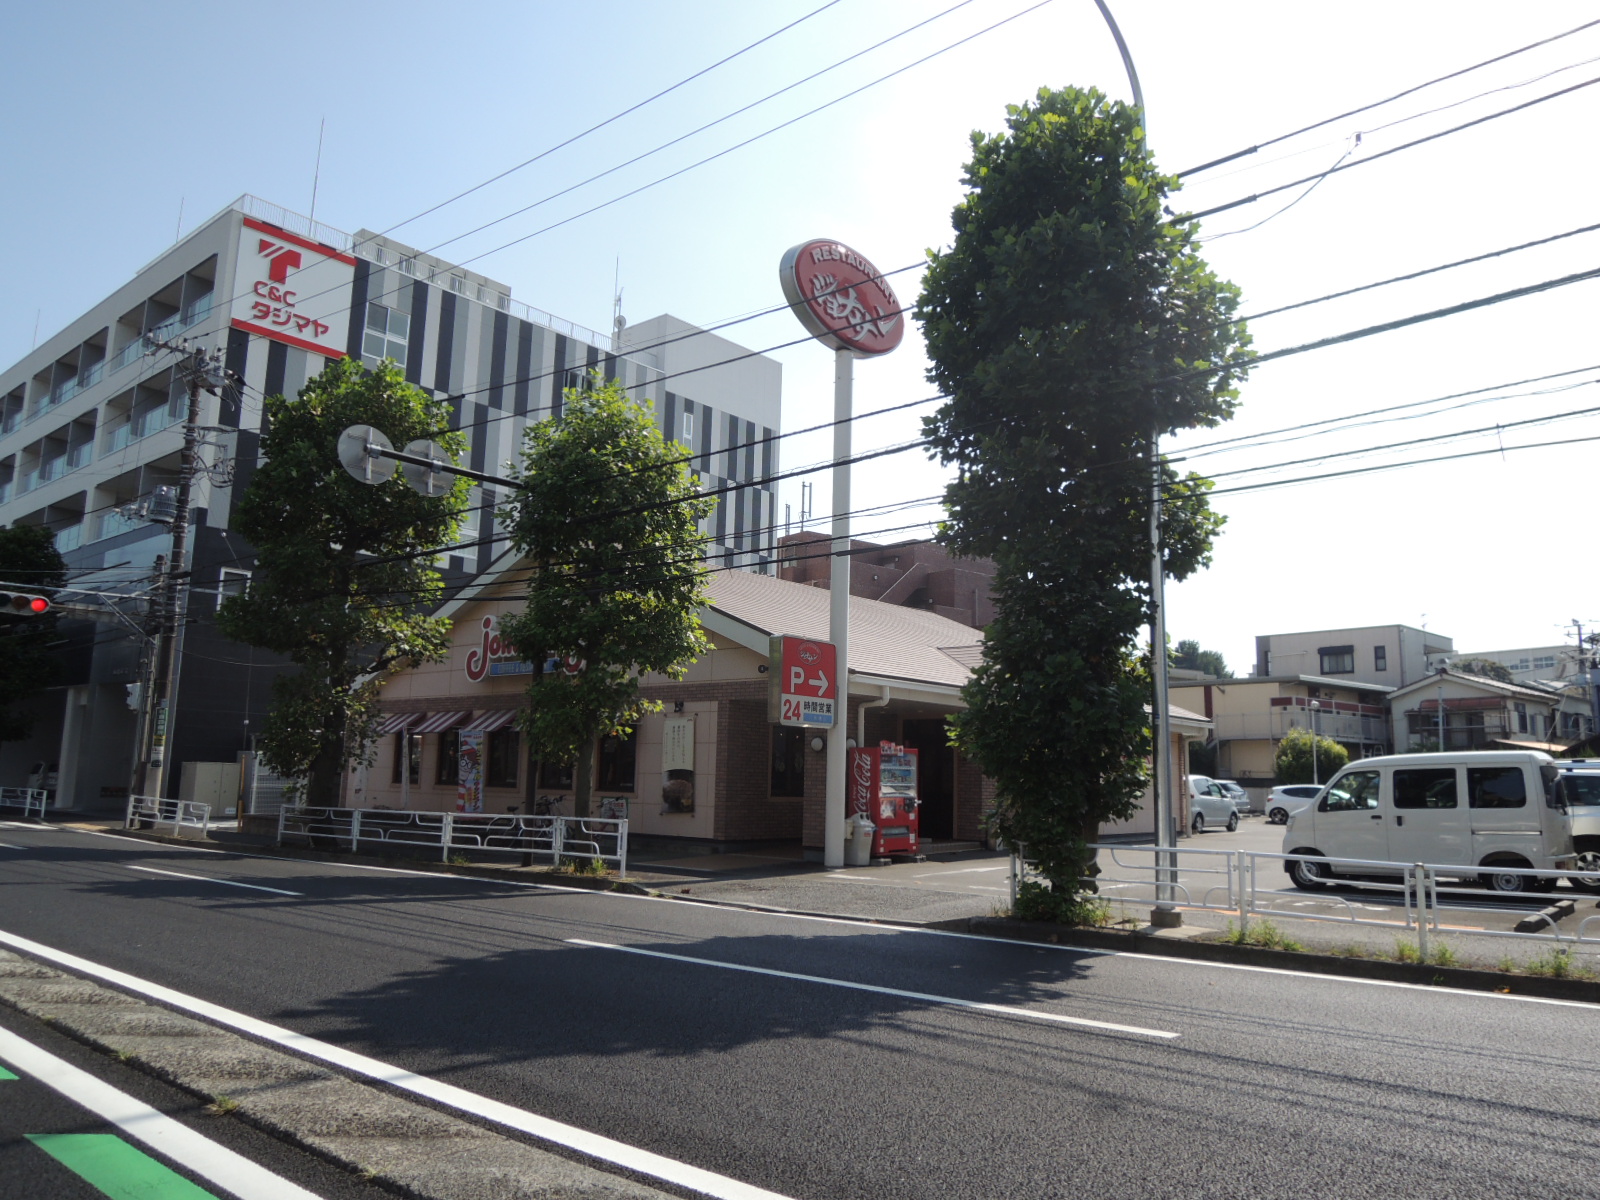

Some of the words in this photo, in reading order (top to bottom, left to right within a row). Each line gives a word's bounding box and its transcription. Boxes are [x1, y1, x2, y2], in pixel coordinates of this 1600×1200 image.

[811, 244, 896, 303] RESTAURANT
[253, 280, 297, 308] C&C
[810, 272, 899, 341] ジョナサン
[251, 300, 330, 338] タジマヤ
[790, 665, 805, 693] P
[783, 698, 801, 721] 24
[803, 701, 832, 714] 時間営業
